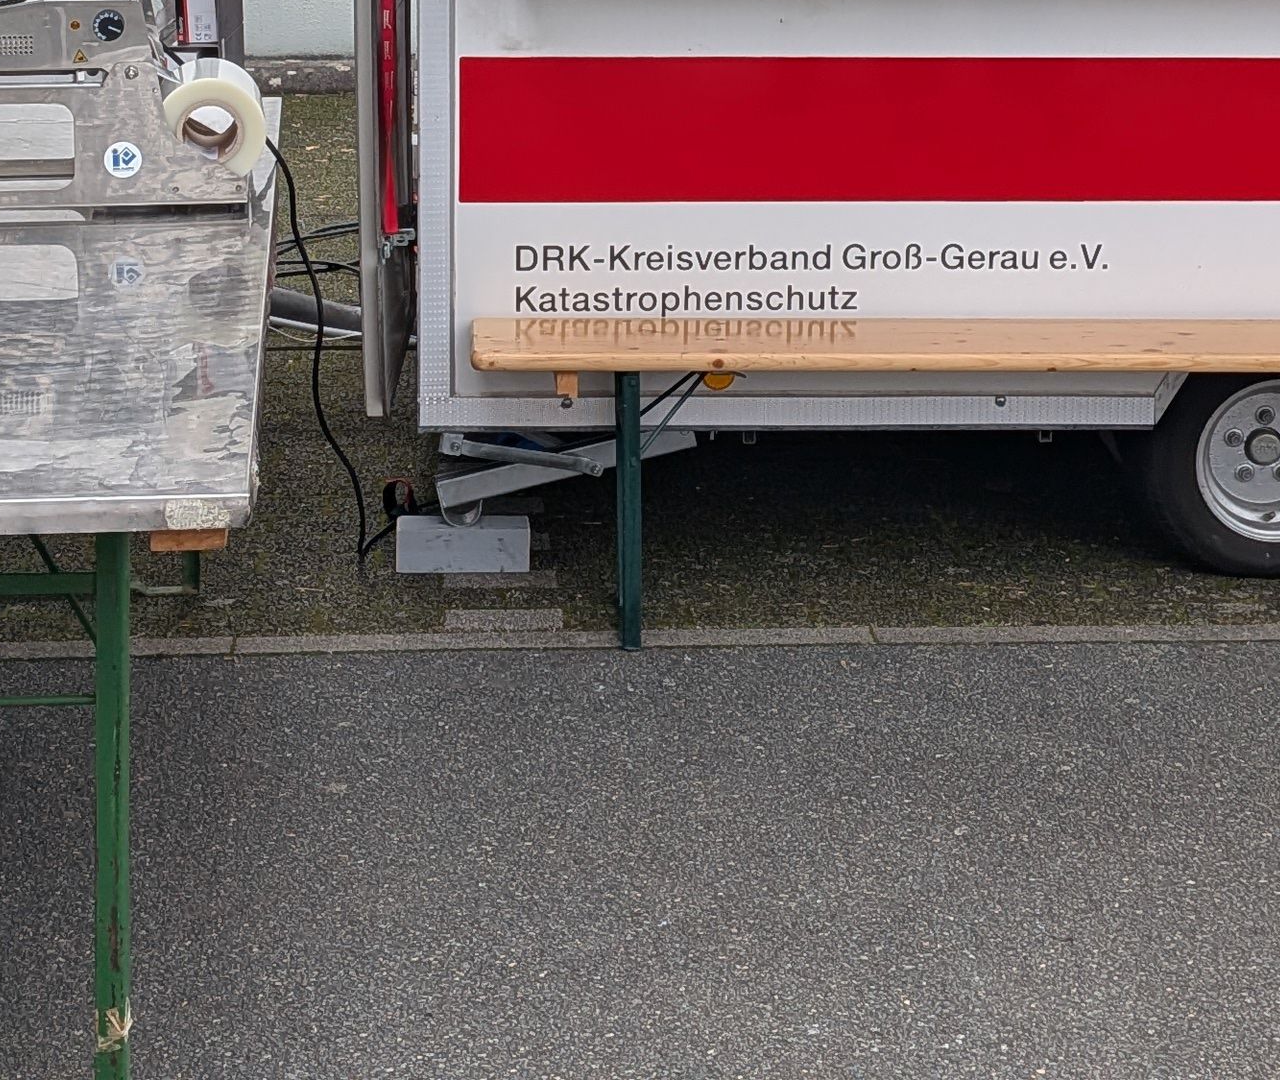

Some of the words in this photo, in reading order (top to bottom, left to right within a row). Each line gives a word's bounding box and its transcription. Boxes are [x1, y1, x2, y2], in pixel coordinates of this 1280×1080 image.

[515, 244, 832, 272] DRK-Kreisverband
[842, 243, 1039, 271] Groß-Gerau
[1049, 244, 1108, 270] e.V.
[515, 284, 858, 318] Katastrophenschutz
